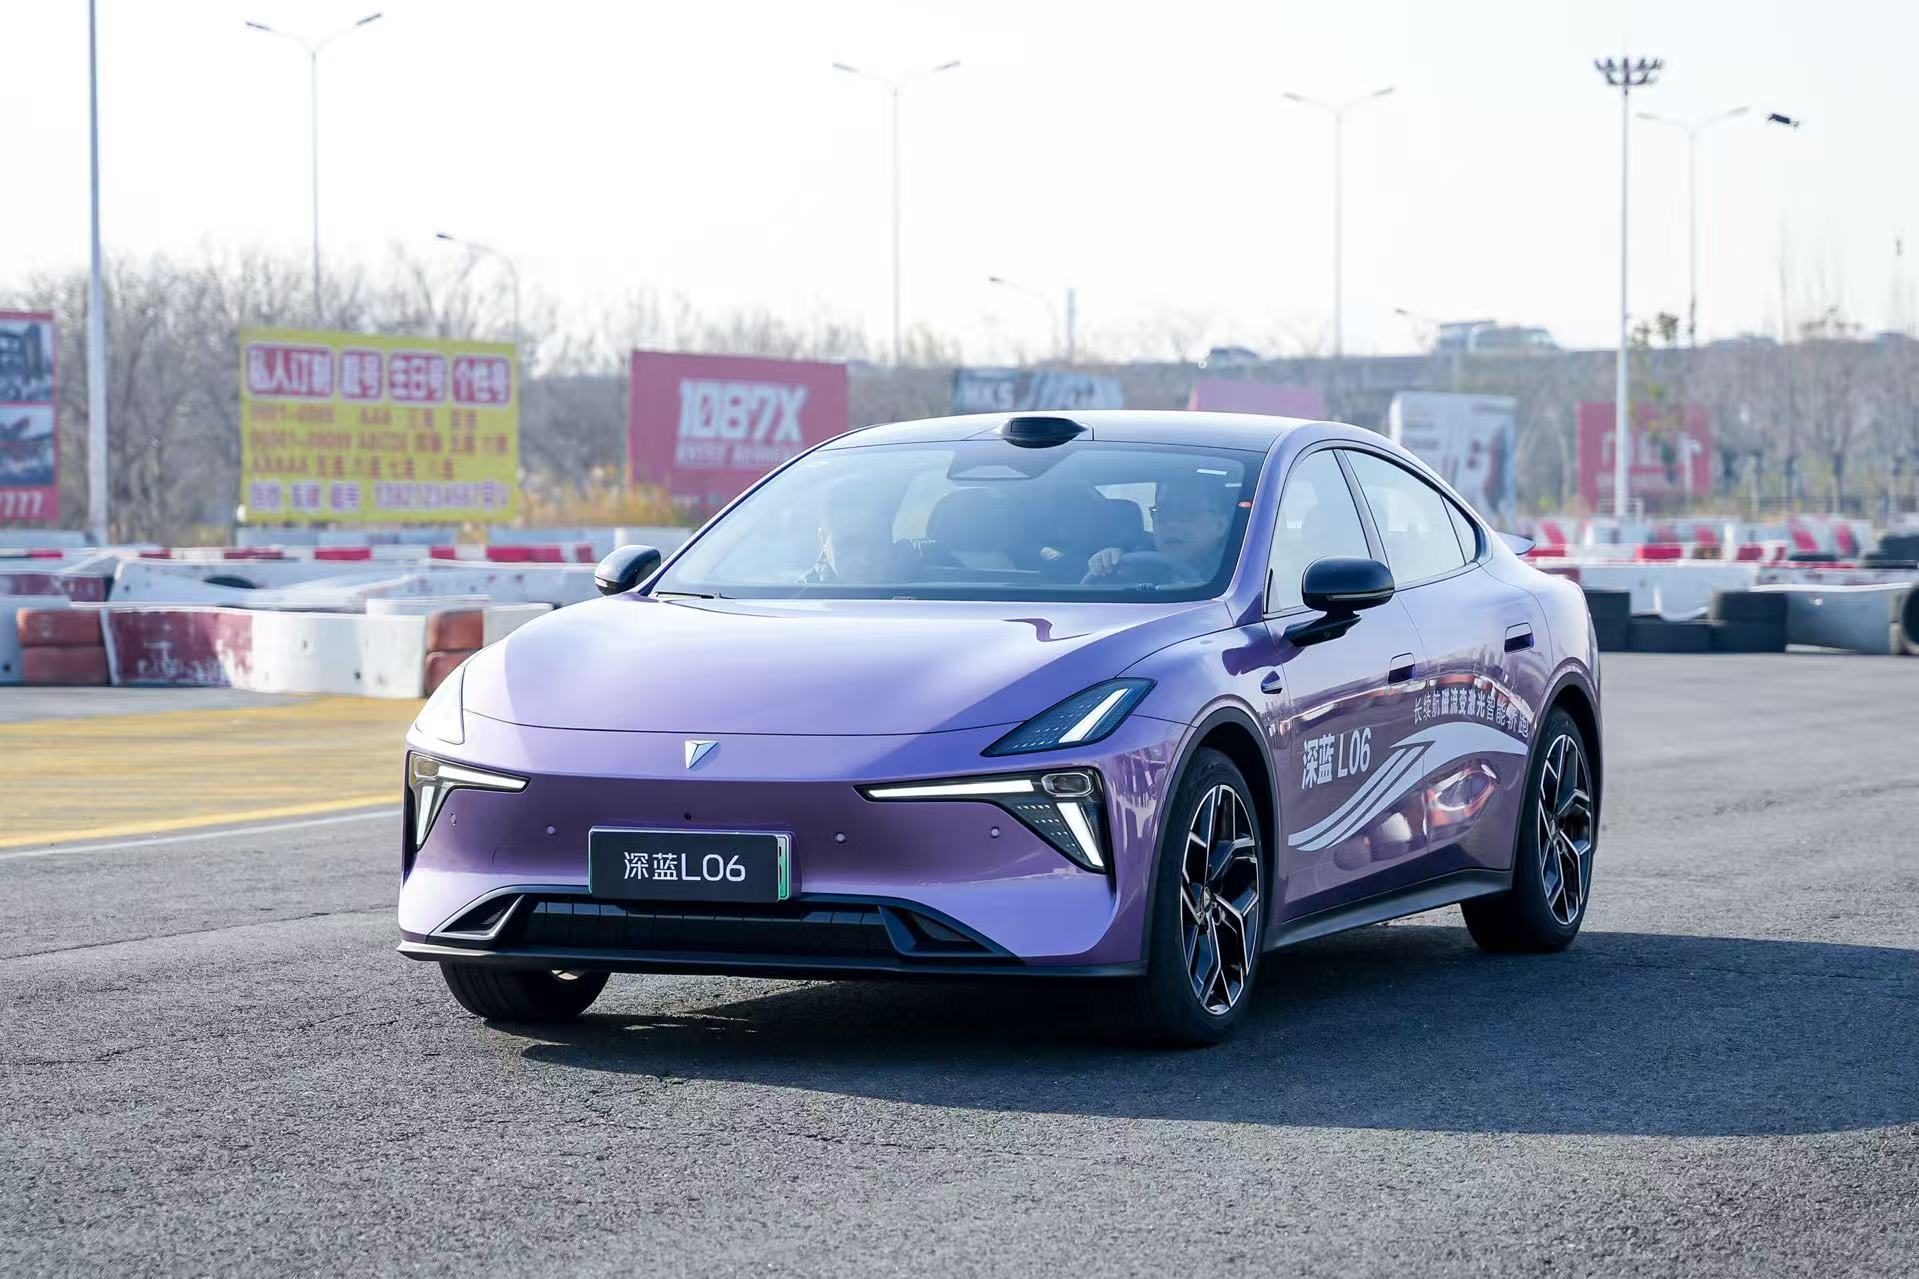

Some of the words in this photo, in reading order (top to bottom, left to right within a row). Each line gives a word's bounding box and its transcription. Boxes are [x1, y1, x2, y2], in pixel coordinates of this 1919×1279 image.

[0, 490, 43, 517] 777
[1302, 733, 1335, 790] 深蓝
[1337, 727, 1372, 778] L06
[624, 852, 746, 882] 深蓝L06
